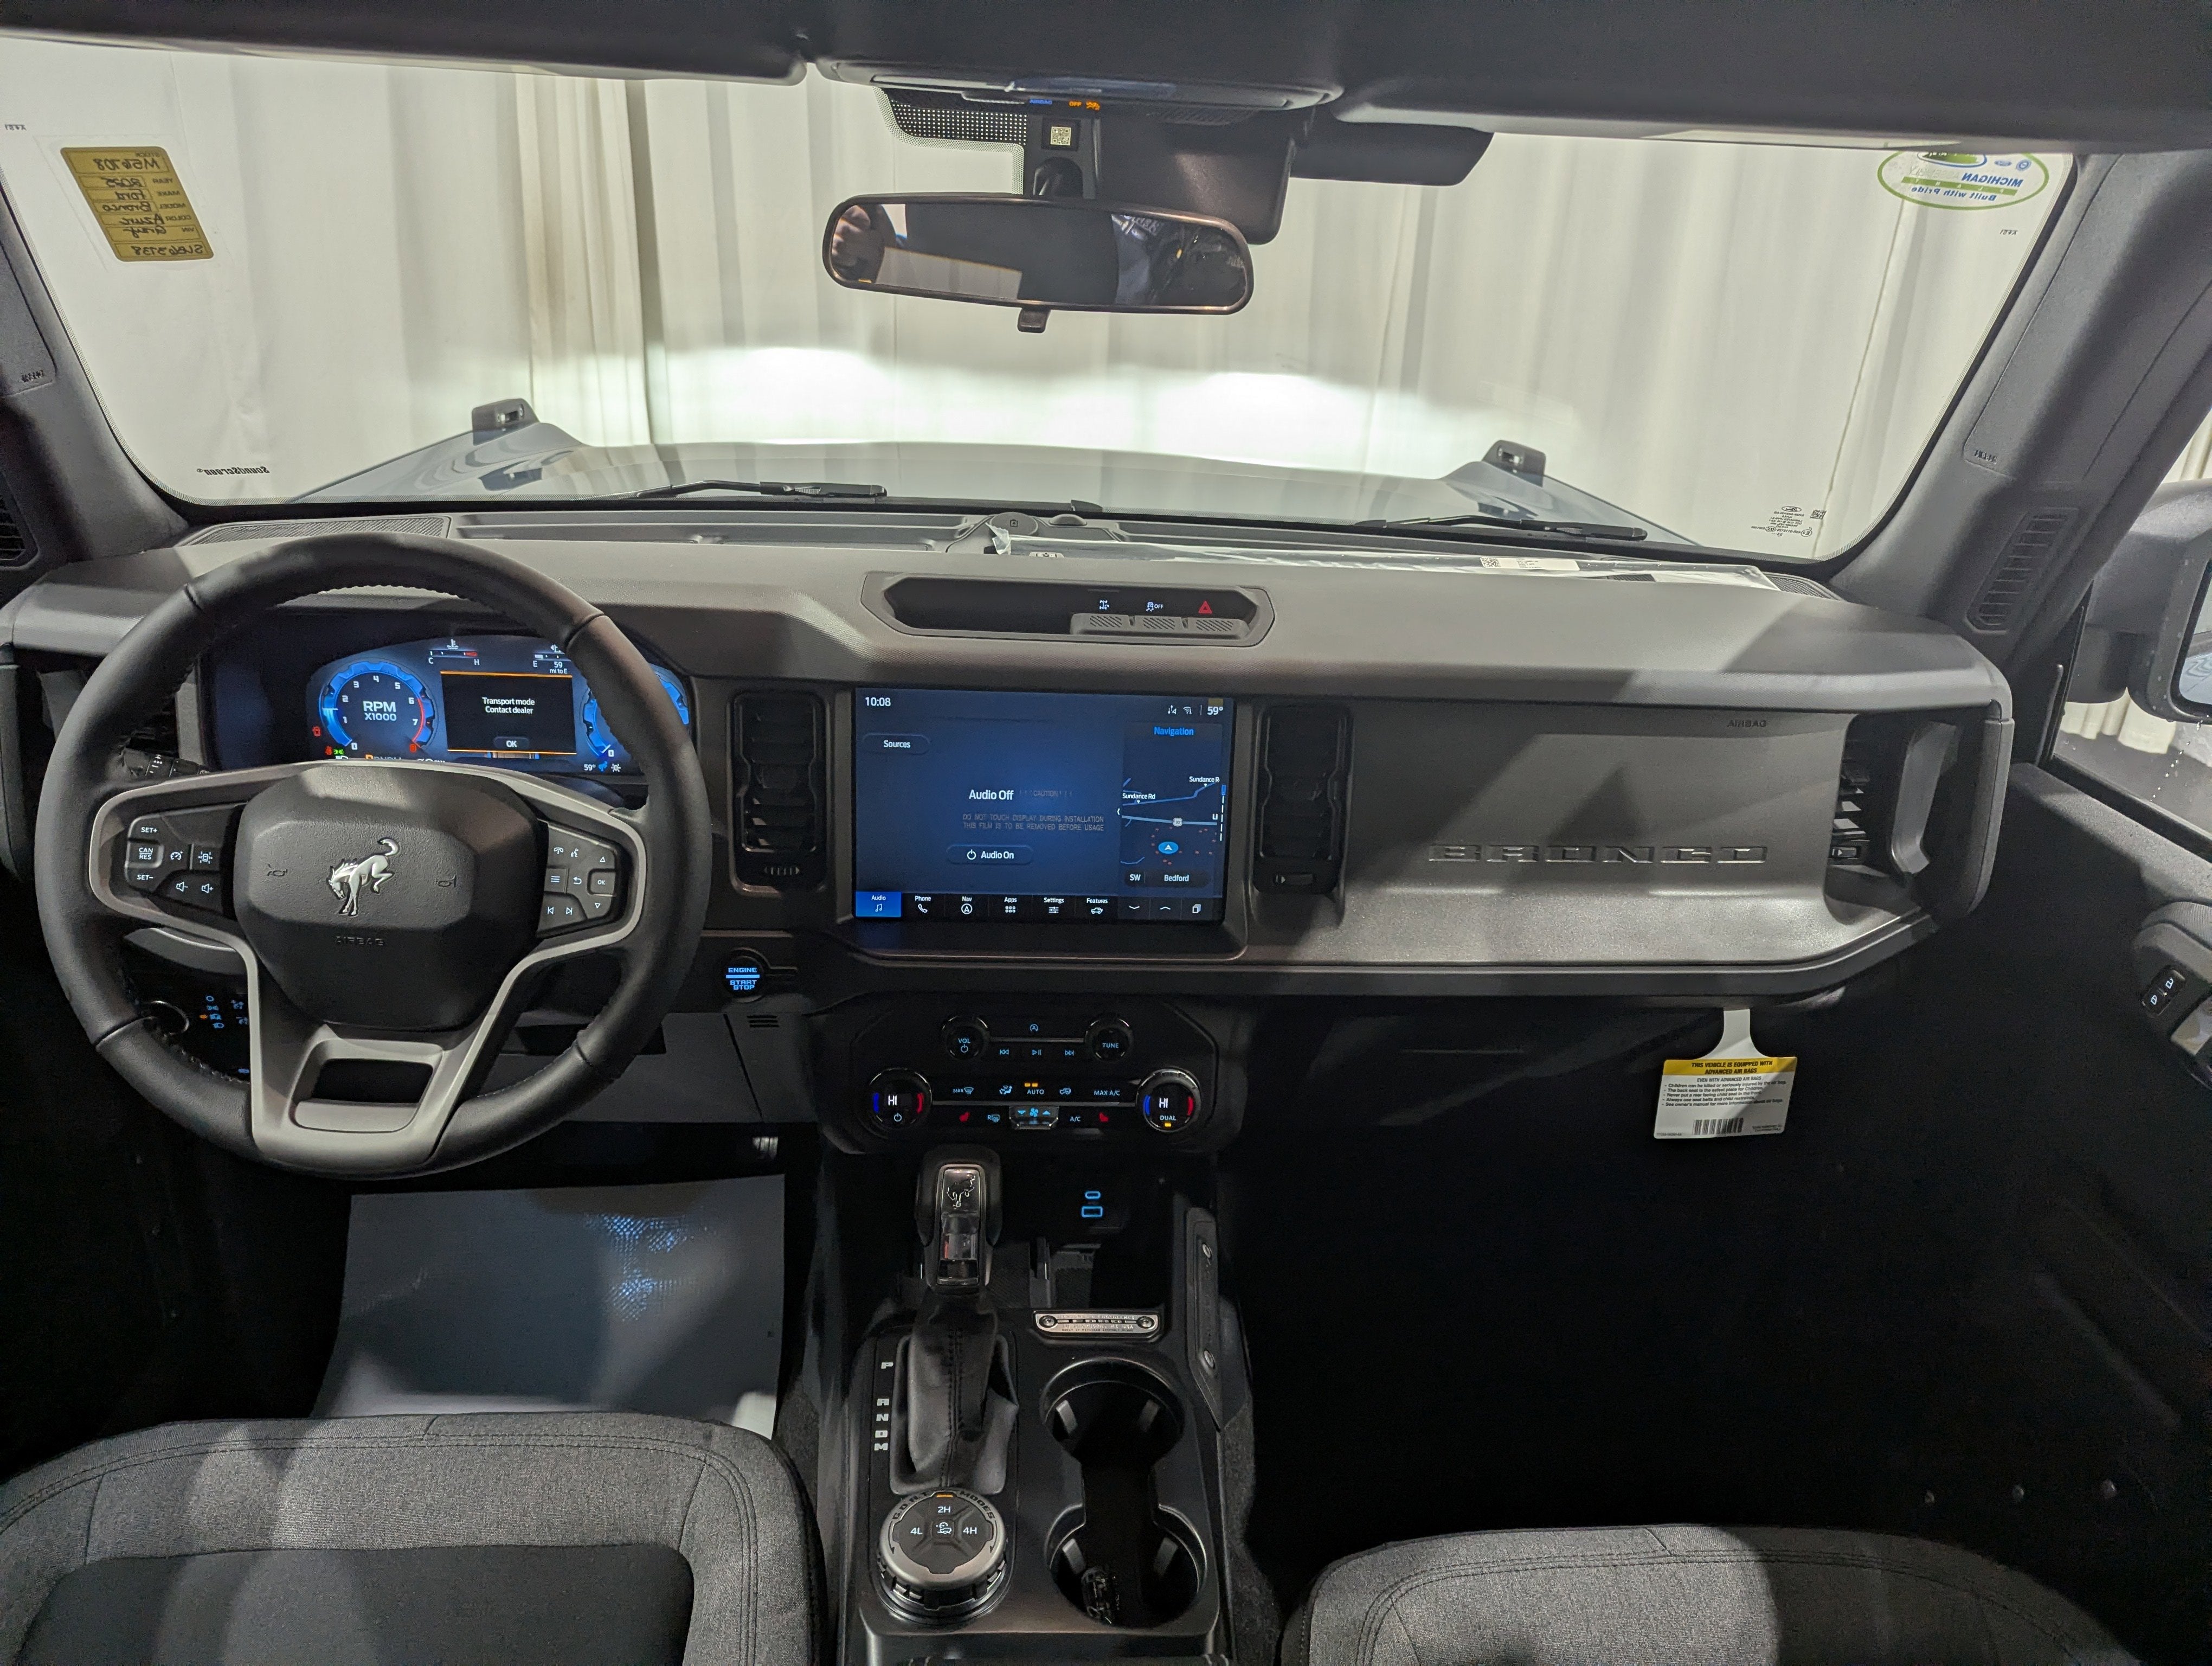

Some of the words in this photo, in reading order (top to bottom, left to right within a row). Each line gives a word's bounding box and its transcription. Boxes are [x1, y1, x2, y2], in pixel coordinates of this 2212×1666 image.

[482, 697, 515, 706] Transport
[865, 697, 891, 706] 10:08
[363, 701, 396, 713] RPM
[1207, 706, 1223, 715] 59°
[1154, 727, 1194, 736] Navigation
[883, 740, 911, 748] Sources
[969, 789, 997, 799] Audio
[999, 790, 1014, 800] Off
[981, 851, 1002, 859] Audio
[1004, 851, 1014, 859] On
[1429, 844, 1768, 863] BRONCO
[336, 936, 384, 946] AIRBAG
[888, 1095, 897, 1106] HI
[1159, 1098, 1168, 1108] HI
[874, 1443, 888, 1451] M
[960, 1491, 995, 1519] MODES
